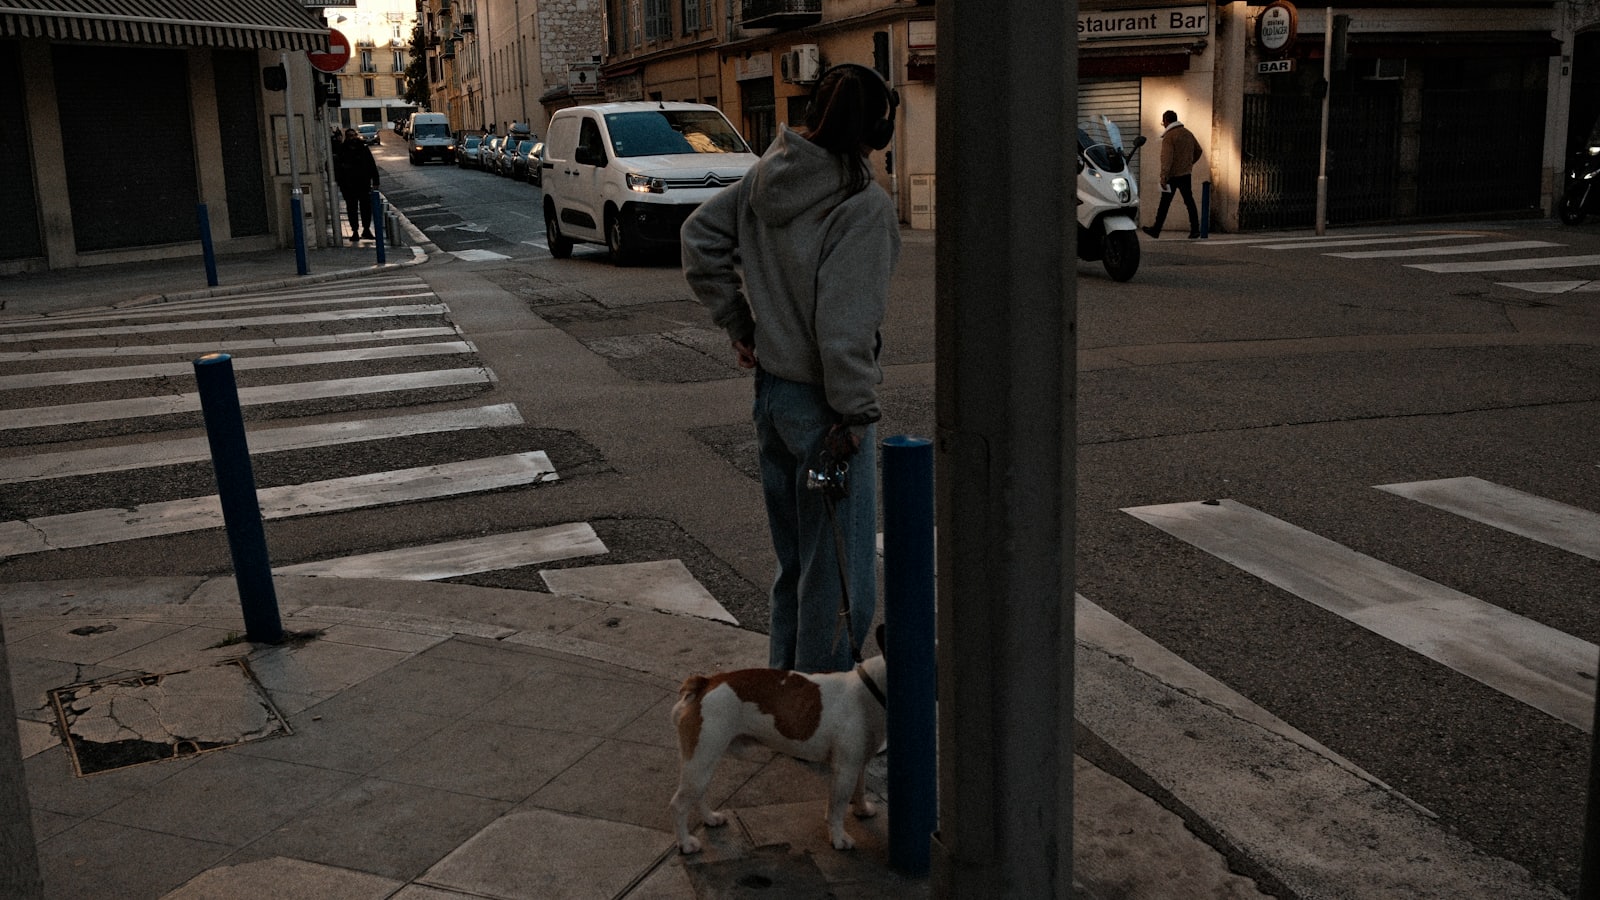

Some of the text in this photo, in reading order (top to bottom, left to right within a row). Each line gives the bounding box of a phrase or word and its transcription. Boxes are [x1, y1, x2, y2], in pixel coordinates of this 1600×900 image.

[1077, 12, 1206, 32] staurant Bar
[1260, 63, 1287, 72] BAR
